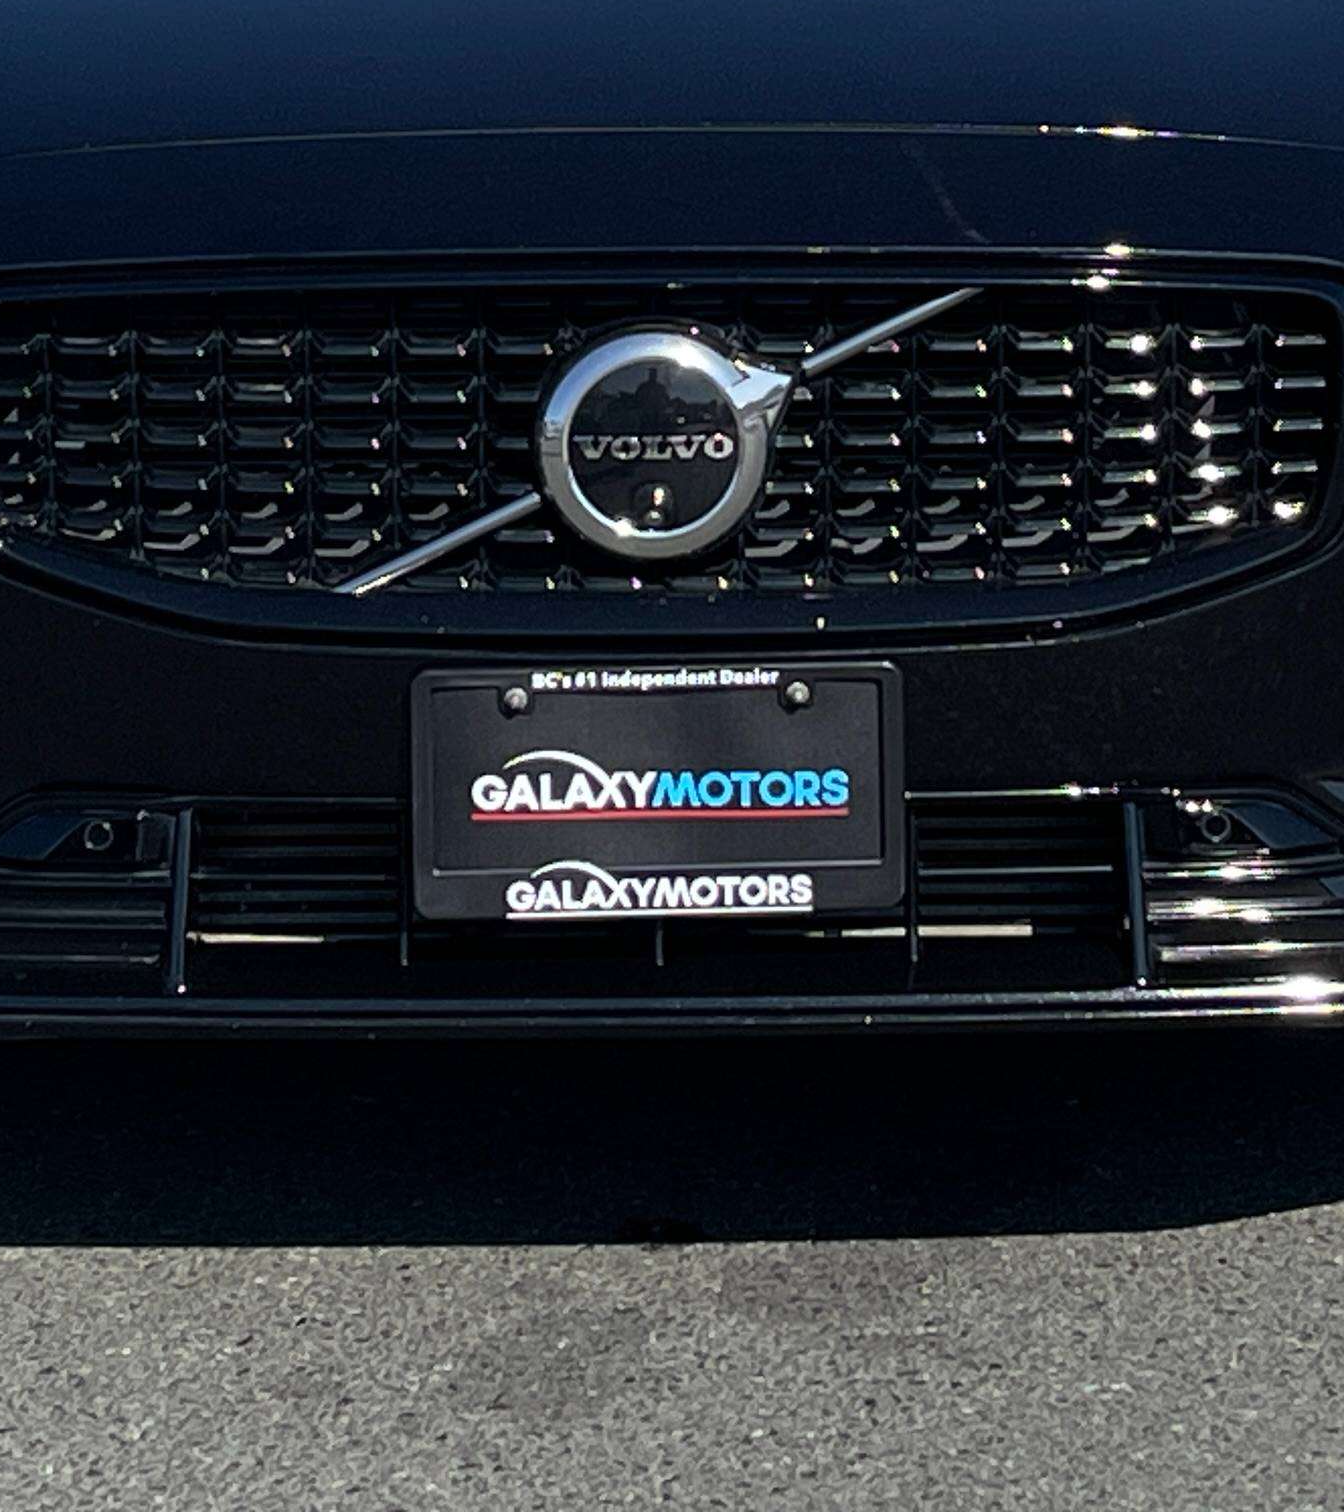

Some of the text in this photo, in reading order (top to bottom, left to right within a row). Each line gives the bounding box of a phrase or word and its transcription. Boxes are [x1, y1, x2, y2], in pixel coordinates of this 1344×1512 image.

[572, 432, 734, 460] VOLVO
[602, 669, 716, 690] Independent
[720, 668, 780, 686] Dealer
[471, 750, 850, 812] GALAXYMOTORS
[505, 860, 813, 911] GALAXYMOTORS
